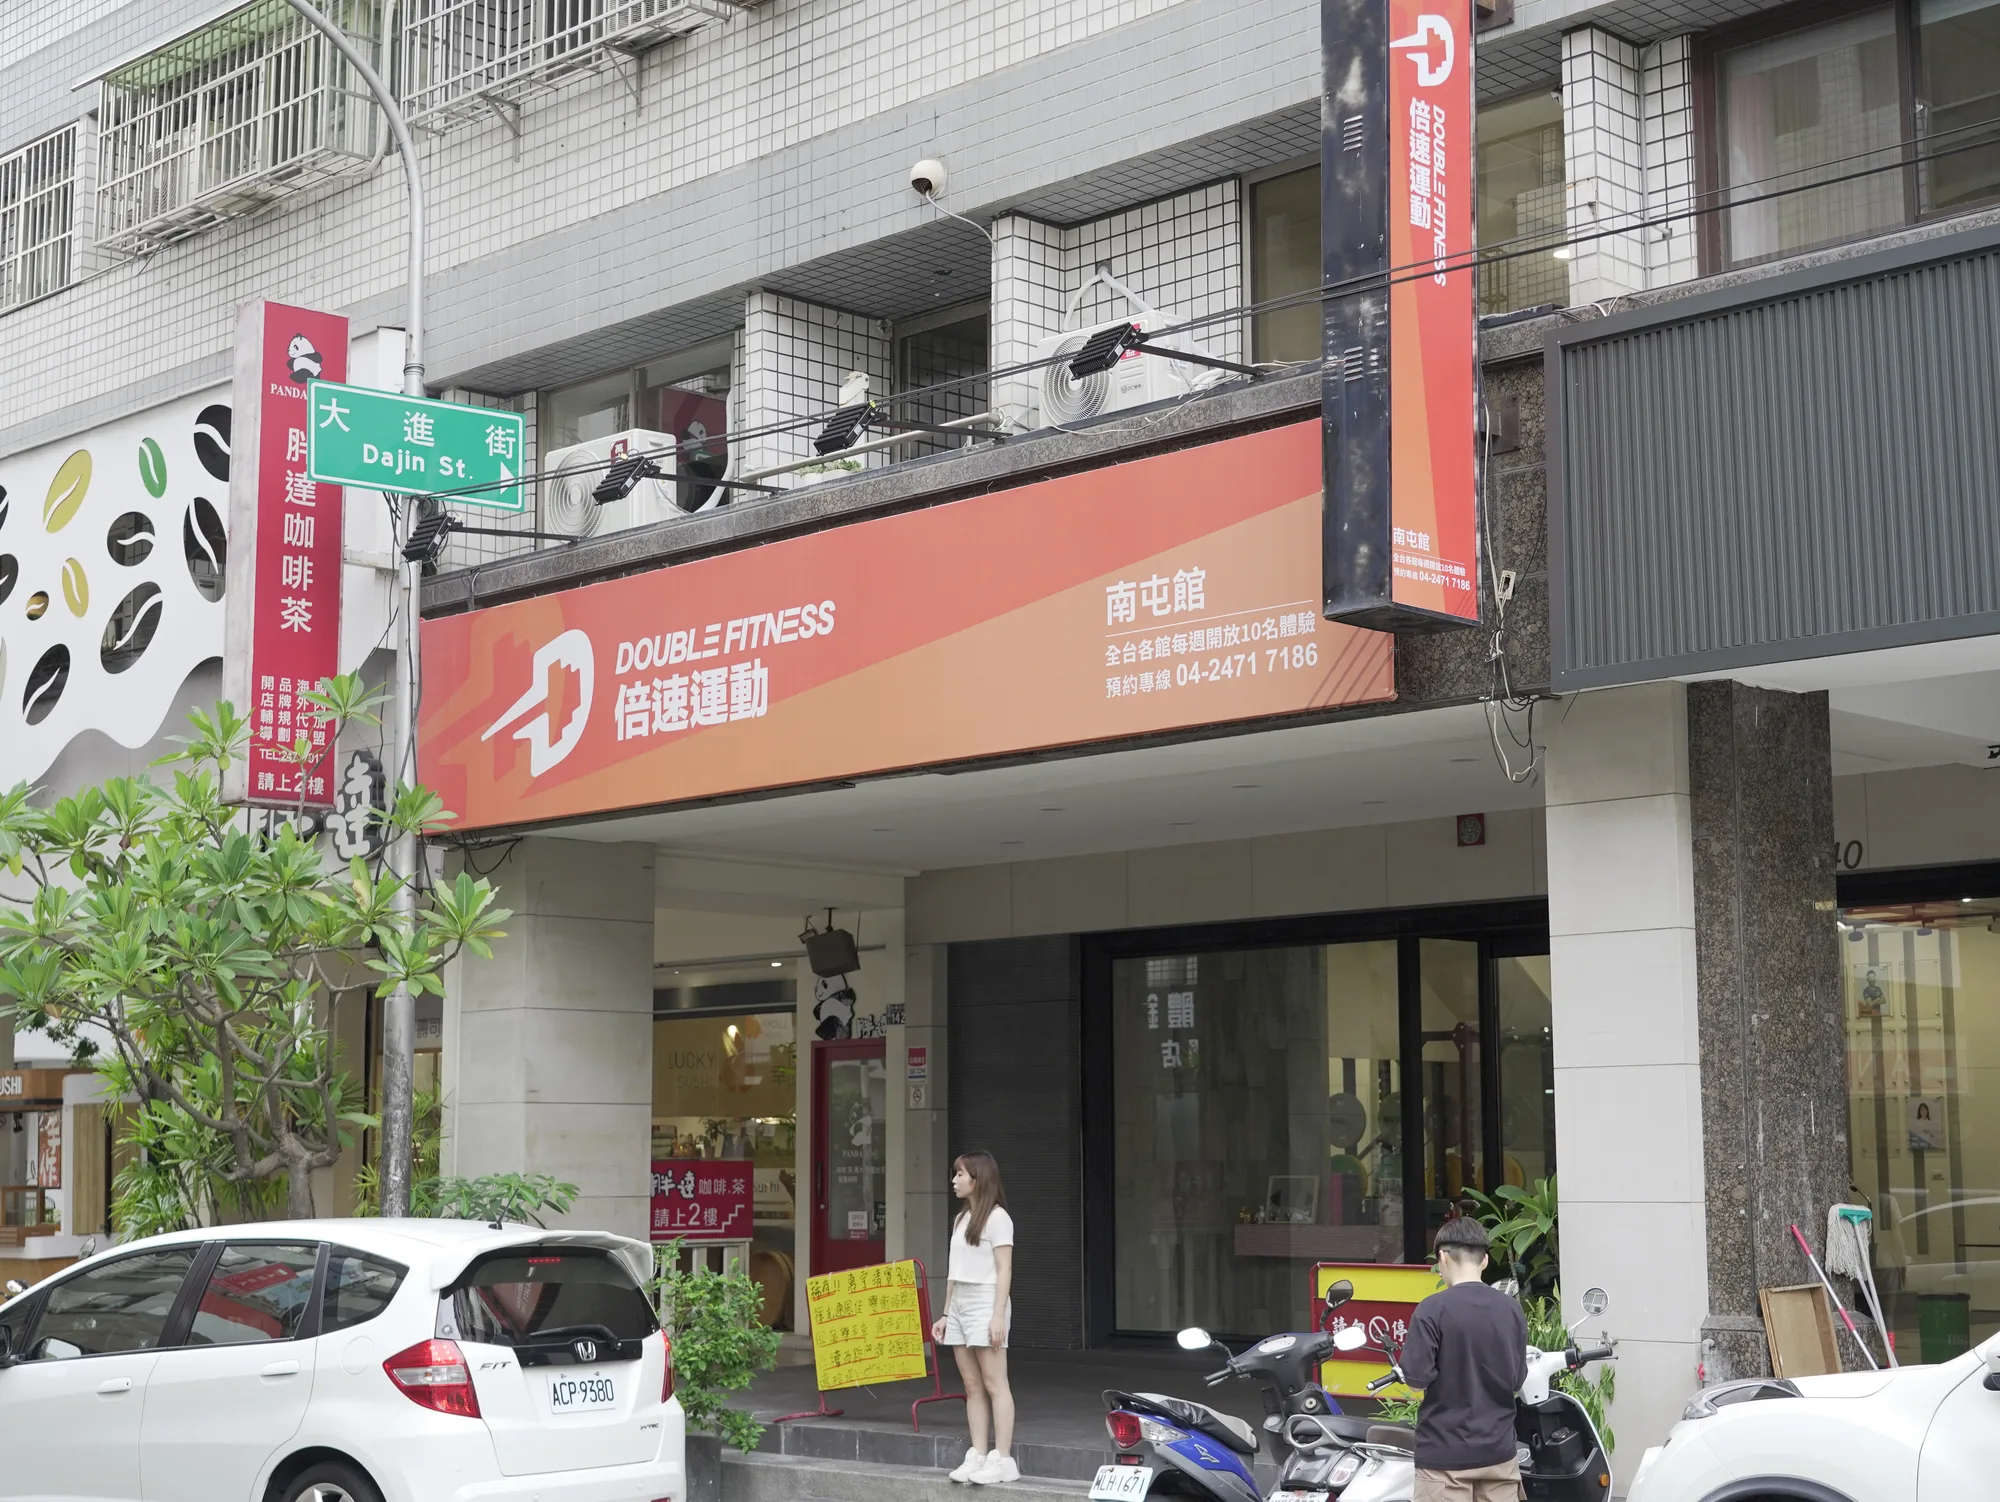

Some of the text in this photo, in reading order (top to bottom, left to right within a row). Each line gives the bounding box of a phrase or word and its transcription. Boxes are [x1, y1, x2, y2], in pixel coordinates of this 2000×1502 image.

[1409, 96, 1432, 230] 倍速運動
[1432, 103, 1447, 287] DOUBLE FITNESS
[362, 443, 474, 480] Dajin St.
[1392, 526, 1431, 552] 南屯館
[1105, 565, 1207, 627] 南屯館
[1419, 570, 1451, 588] 04-2471
[1451, 577, 1472, 592] 7186
[614, 599, 836, 676] DOUBLE FITNESS
[1105, 609, 1317, 668] 全台各館每週開放10名體驗
[614, 657, 769, 742] 倍速運動
[1105, 642, 1319, 699] 預約專線 04-2471 7186
[259, 675, 275, 741] 開店輔導
[277, 677, 292, 743] 品牌規劃
[257, 771, 325, 796] 請上2樓
[668, 1050, 716, 1071] LUCKY
[653, 1202, 719, 1230] 請上2樓
[480, 1360, 512, 1371] FIT
